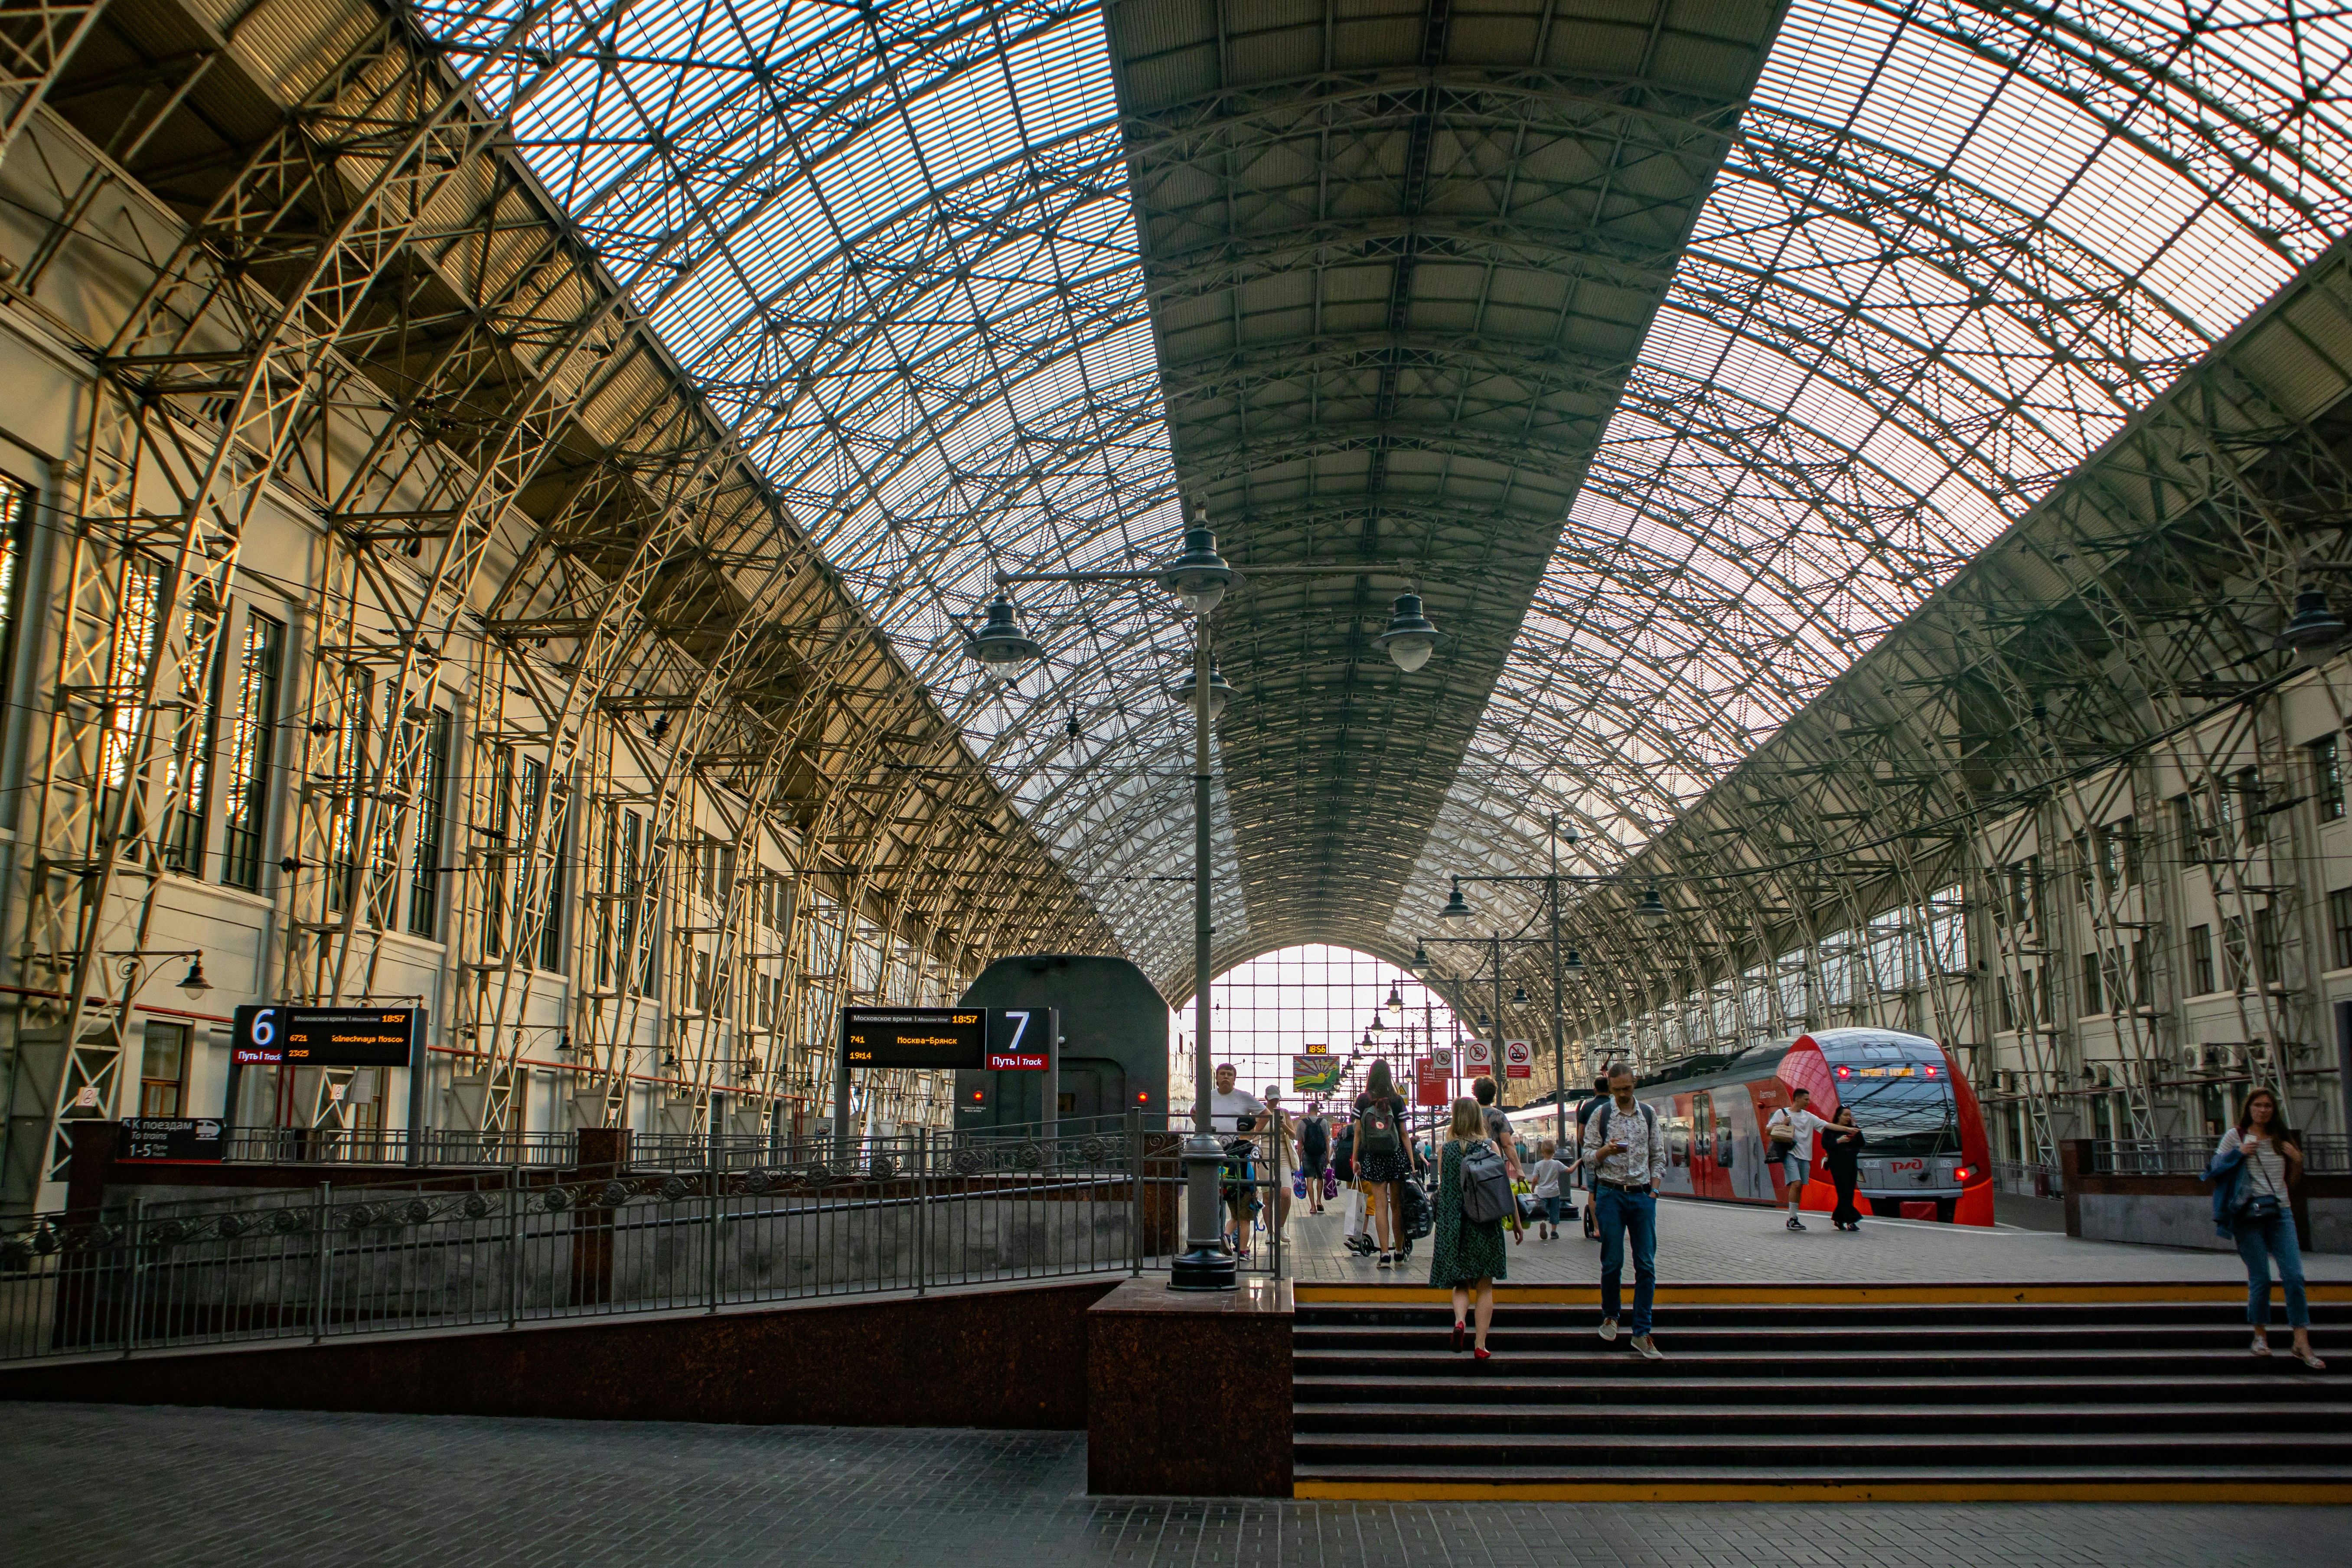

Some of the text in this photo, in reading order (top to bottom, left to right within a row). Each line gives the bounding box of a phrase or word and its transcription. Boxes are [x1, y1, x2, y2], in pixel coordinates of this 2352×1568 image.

[251, 1009, 275, 1046] 6
[1006, 1011, 1029, 1049] 7
[897, 1037, 957, 1045] Москва-Брянск
[238, 1051, 259, 1062] Путь
[993, 1056, 1015, 1067] Путь
[132, 1119, 193, 1131] К поездам
[130, 1144, 152, 1157] 1-5
